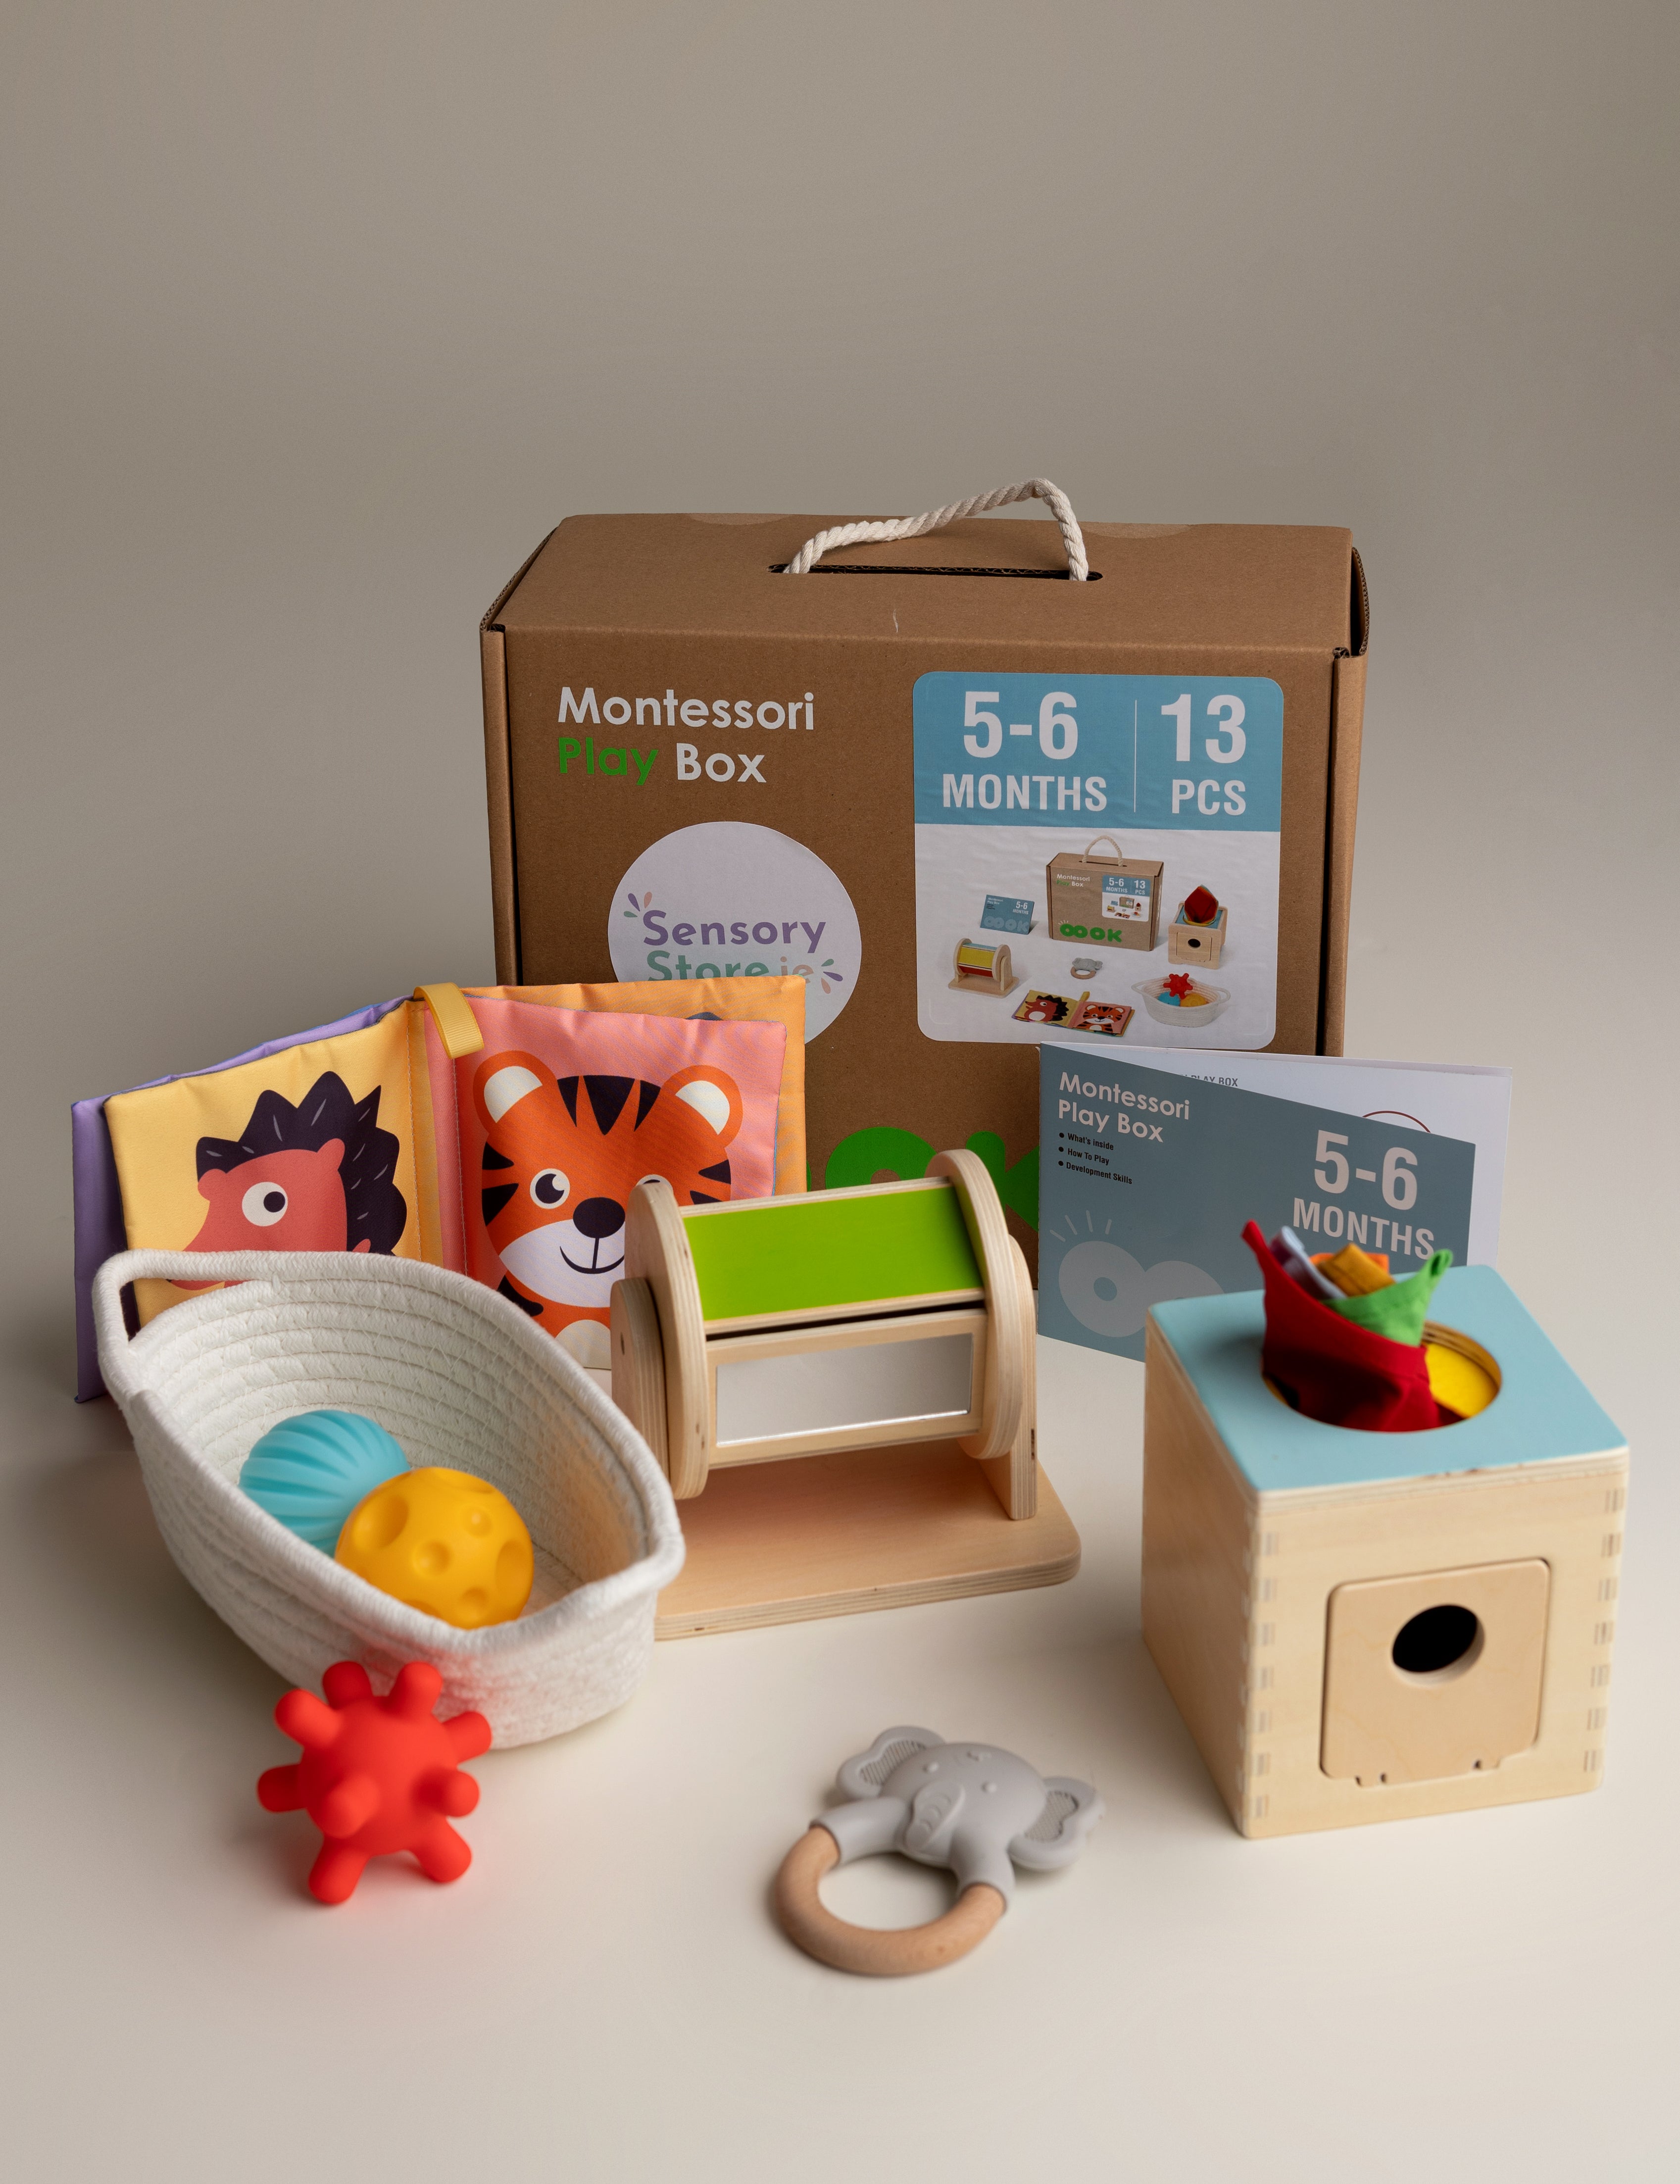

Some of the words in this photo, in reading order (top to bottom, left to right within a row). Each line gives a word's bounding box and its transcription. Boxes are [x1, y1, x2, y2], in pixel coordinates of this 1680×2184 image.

[558, 687, 814, 730] Montessori
[963, 691, 1078, 759] 5-6
[1161, 694, 1246, 763] 13
[558, 737, 658, 785] Play
[677, 743, 766, 783] Box
[943, 773, 1107, 812] MONTHS
[1172, 779, 1246, 815] PCS
[1109, 878, 1124, 887] 5-6
[1134, 880, 1145, 889] 13
[1016, 901, 1028, 909] 5-6
[643, 910, 826, 953] Sensory
[1059, 1072, 1189, 1120] Montessori
[1219, 1077, 1238, 1087] BOX
[1059, 1099, 1110, 1133] Play
[1118, 1112, 1163, 1142] Box
[1068, 1133, 1090, 1144] What's
[1093, 1139, 1114, 1150] inside
[1068, 1148, 1082, 1157] How
[1094, 1154, 1109, 1165] Play
[1066, 1162, 1111, 1179] Development
[1113, 1173, 1132, 1184] Skills
[1314, 1130, 1418, 1210] 5-6
[1293, 1197, 1434, 1260] MONTHS
